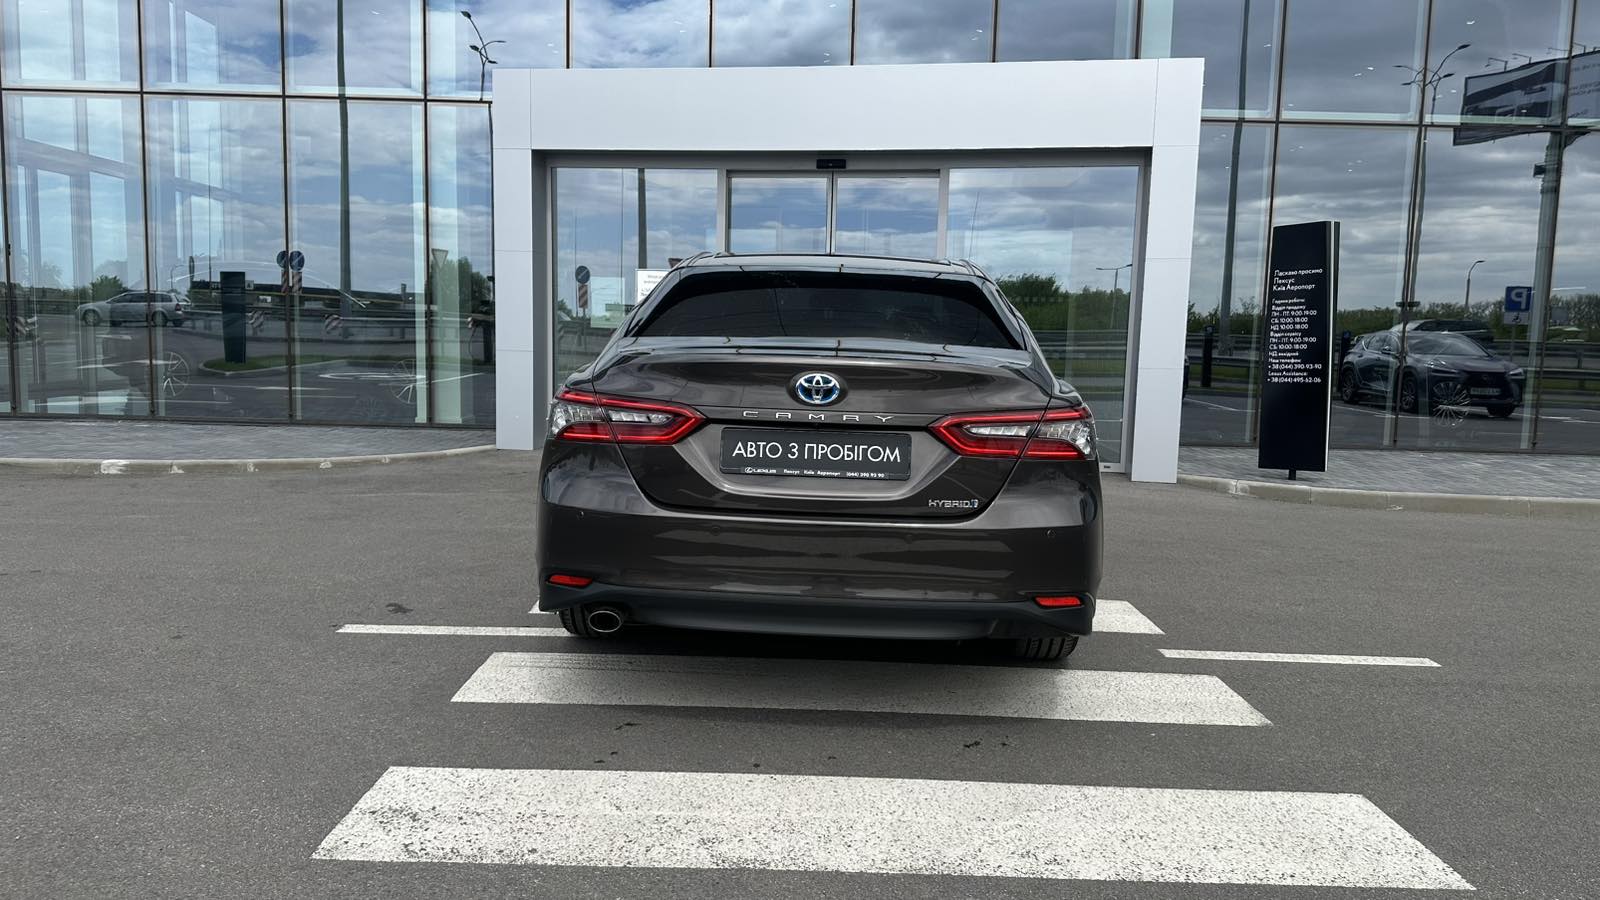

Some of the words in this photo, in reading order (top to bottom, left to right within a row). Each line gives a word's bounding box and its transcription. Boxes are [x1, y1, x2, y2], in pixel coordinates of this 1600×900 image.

[743, 410, 894, 422] CAMRY
[732, 441, 782, 459] АВТО
[804, 444, 901, 462] ПРОБІГОМ
